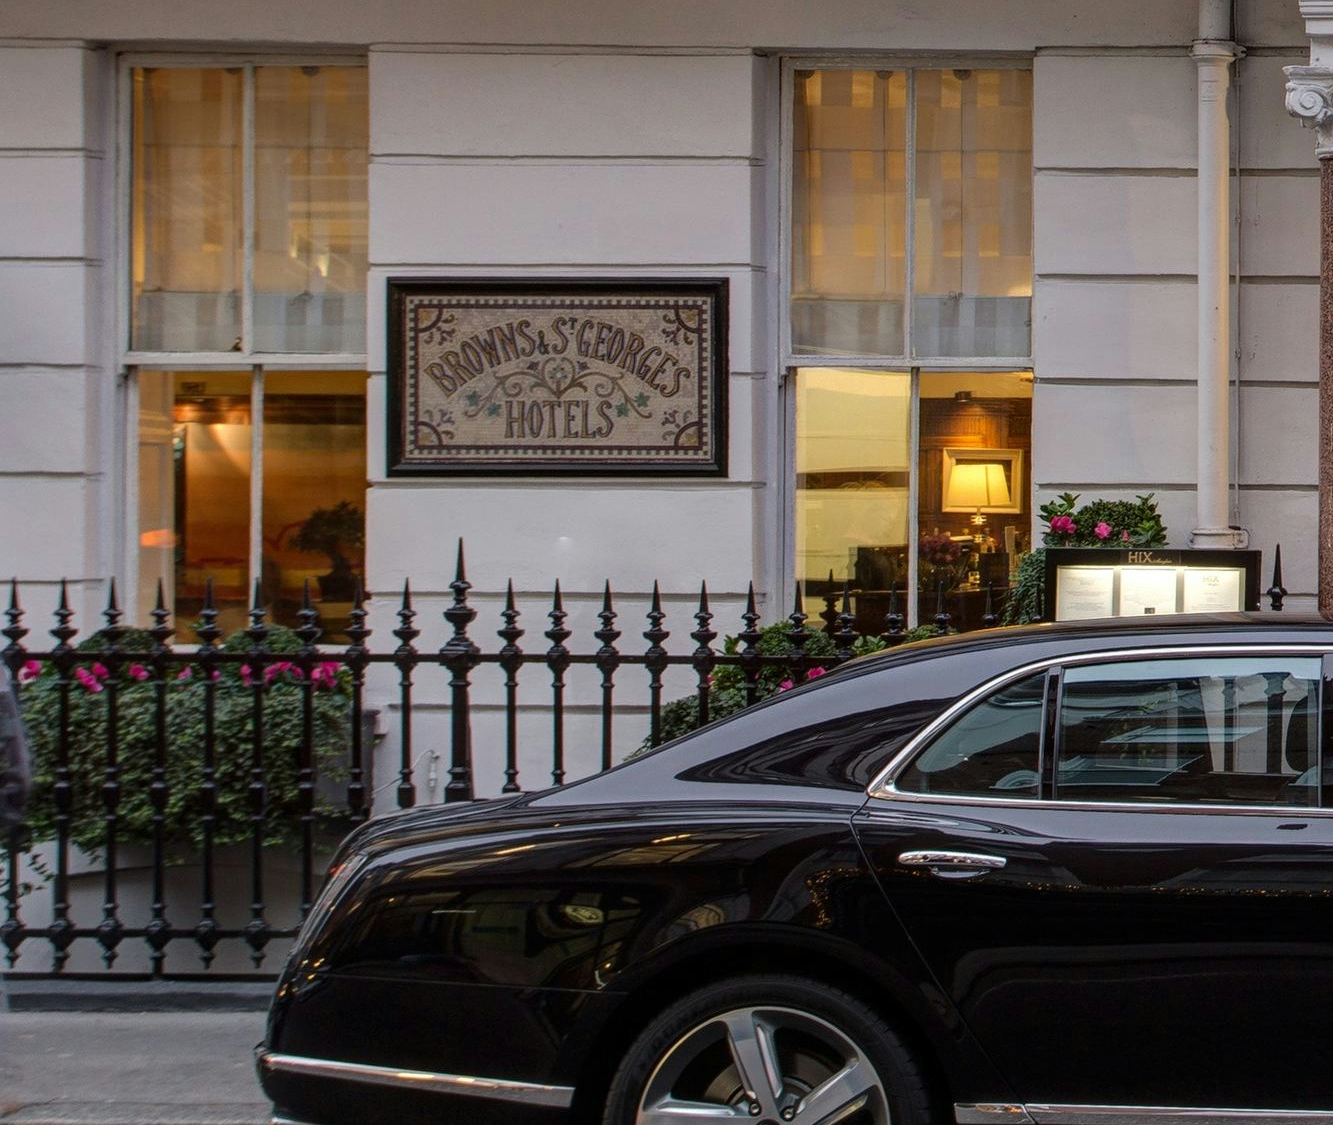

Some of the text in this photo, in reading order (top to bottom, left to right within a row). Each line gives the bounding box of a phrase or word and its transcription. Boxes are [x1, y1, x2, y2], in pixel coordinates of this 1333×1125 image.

[424, 318, 536, 399] BROWNS
[536, 328, 552, 356] &
[575, 318, 692, 399] GEORGES
[504, 399, 615, 439] HOTELS
[1128, 551, 1153, 563] HIX
